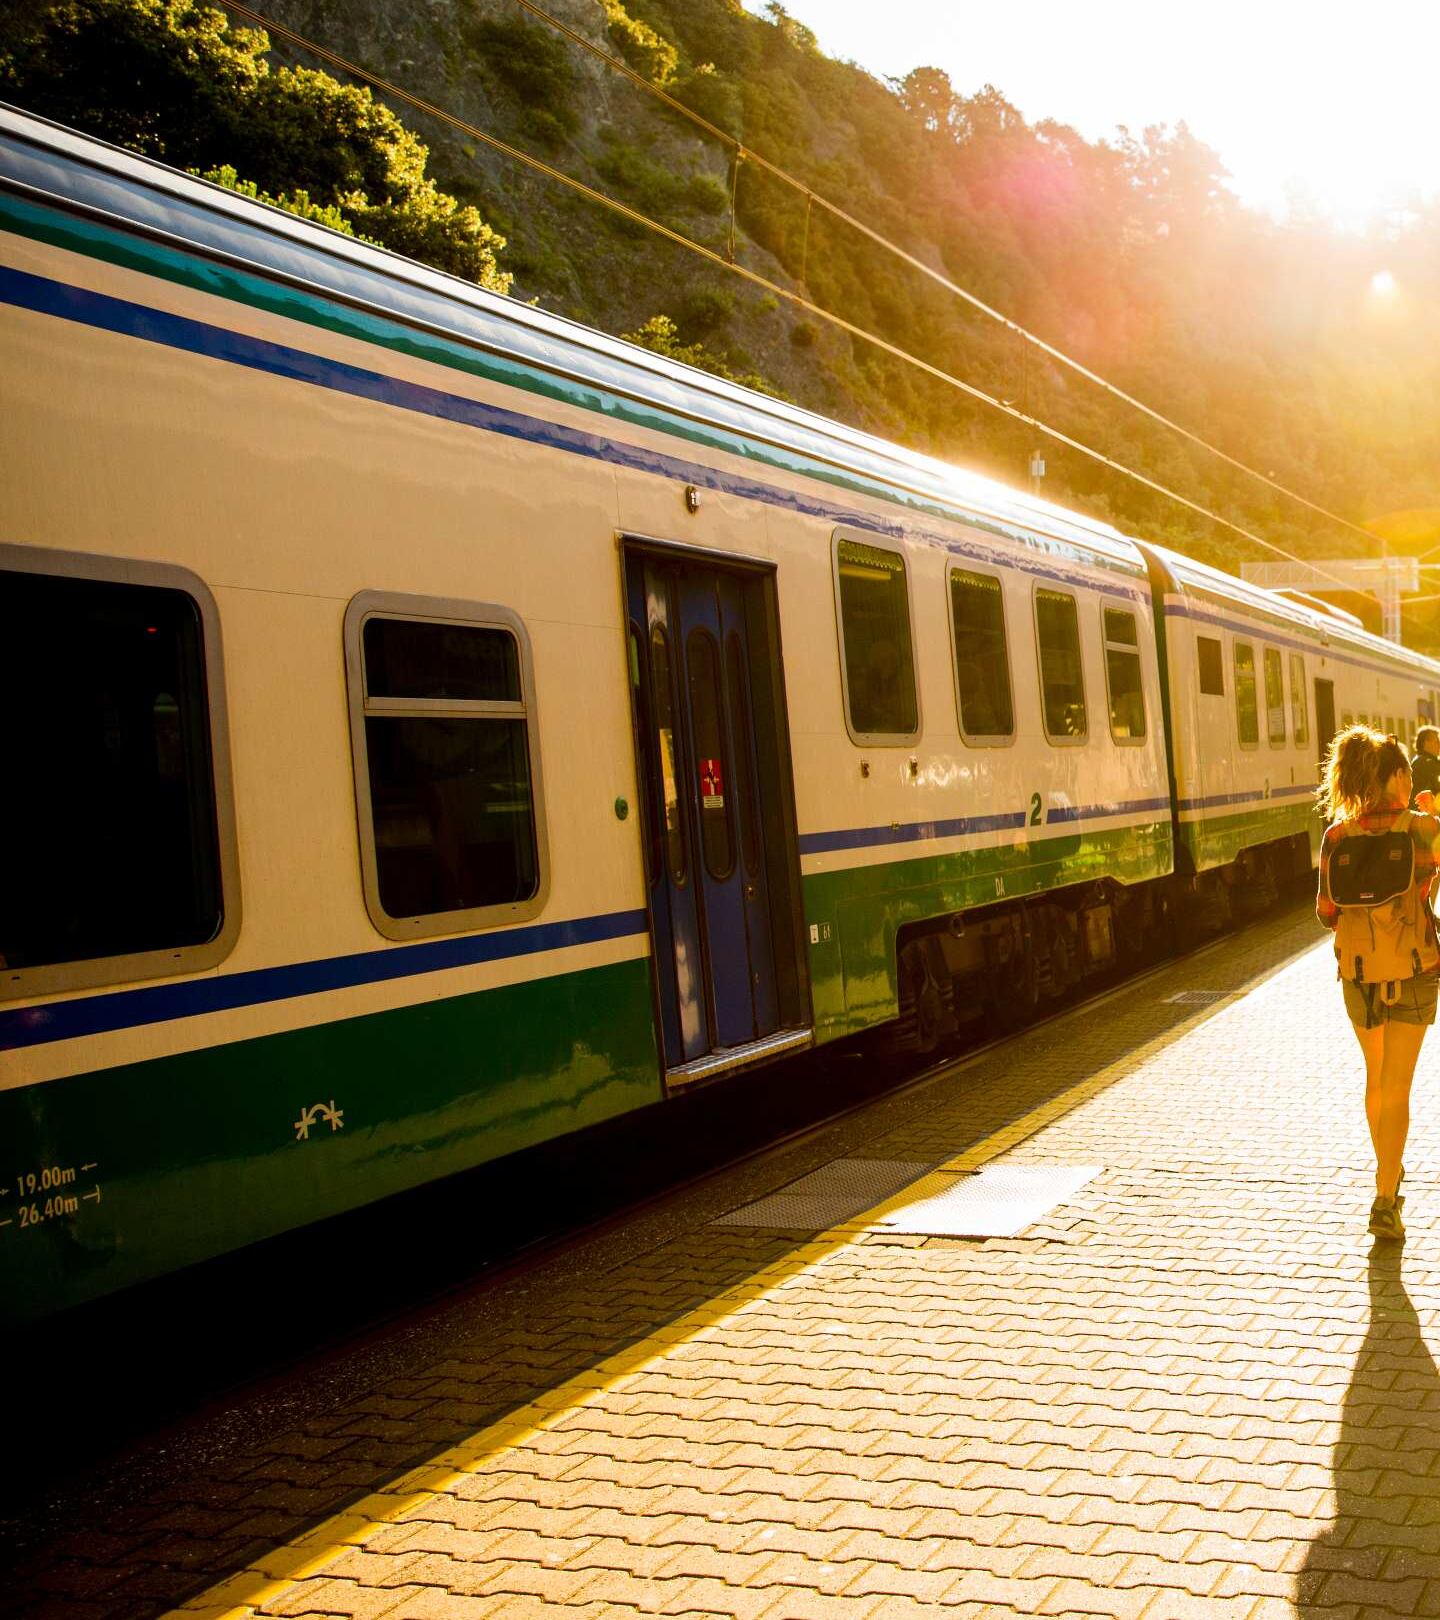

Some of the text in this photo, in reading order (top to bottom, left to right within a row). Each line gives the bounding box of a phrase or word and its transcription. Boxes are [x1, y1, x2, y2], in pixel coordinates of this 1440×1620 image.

[1030, 792, 1041, 826] 2
[17, 1166, 76, 1196] 19.00m
[19, 1195, 78, 1228] 26.40m
